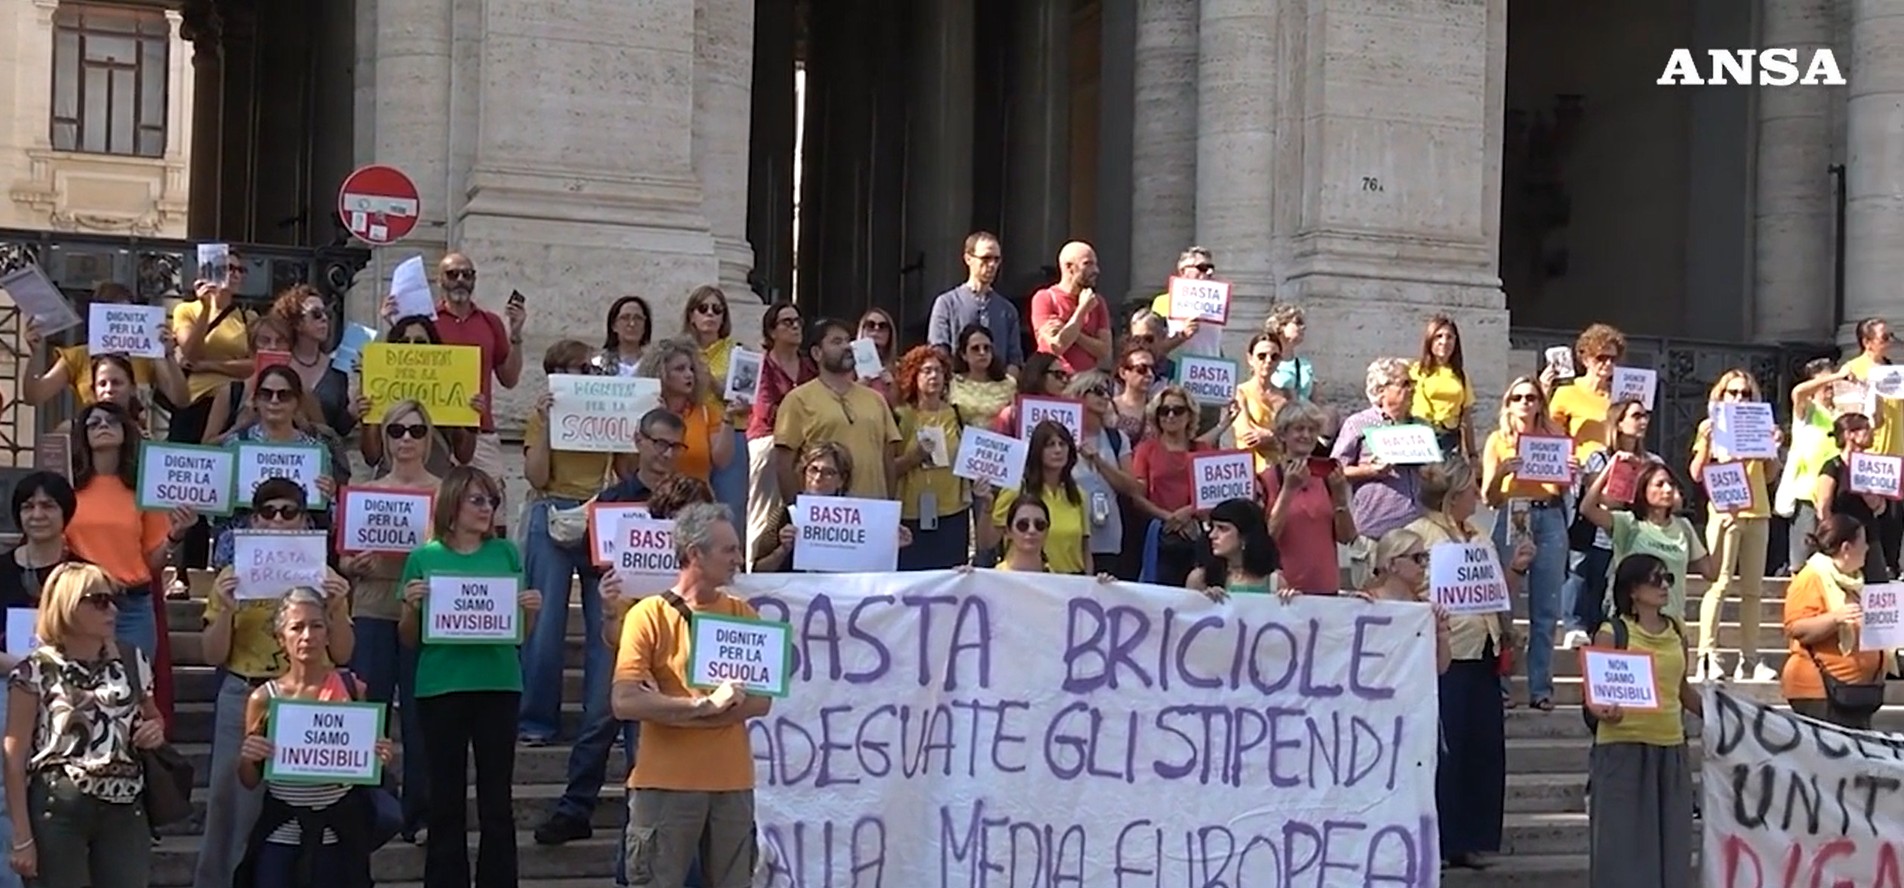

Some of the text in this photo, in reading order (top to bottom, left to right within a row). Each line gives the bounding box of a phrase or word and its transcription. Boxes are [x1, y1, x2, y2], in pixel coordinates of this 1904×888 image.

[1181, 285, 1220, 301] BASTA
[1177, 300, 1223, 314] BRICIOLE
[106, 310, 148, 323] DIGNITA'
[109, 323, 144, 335] PER LA
[101, 335, 151, 350] SCUOLA
[395, 368, 416, 379] PER
[1189, 365, 1230, 383] BASTA
[370, 377, 465, 408] SCUOLA
[1183, 381, 1233, 398] BRICIOLE
[586, 401, 606, 411] PER
[1032, 408, 1075, 426] BASTA
[562, 414, 633, 441] SCUOL
[975, 436, 1012, 453] DIGNITA'
[165, 455, 216, 471] DIGNITA'
[257, 453, 306, 467] DIGNITA'
[976, 447, 1005, 464] PER LA
[1532, 453, 1557, 462] PER LA
[261, 467, 301, 479] PER LA
[966, 458, 1008, 479] SCUOLA
[1204, 462, 1247, 482] BASTA
[1525, 463, 1563, 475] SCUOLA
[1858, 459, 1895, 475] BASTA
[168, 471, 210, 485] PER LA
[1711, 470, 1742, 488] BASTA
[1854, 473, 1897, 490] BRICIOLE
[157, 485, 218, 503] SCUOLA
[1201, 481, 1251, 500] BRICIOLE
[1712, 487, 1748, 503] BRICIOLE
[364, 499, 414, 514] DIGNITA'
[810, 505, 861, 525] BASTA
[368, 513, 408, 527] PER LA
[358, 527, 416, 545] SCUOLA
[629, 529, 673, 550] BAST
[803, 525, 865, 544] BRICIOLE
[253, 549, 306, 566] BASTA
[622, 552, 681, 570] BRICIOL
[1464, 548, 1490, 563] NON
[1457, 565, 1495, 582] SIAMO
[461, 583, 488, 596] NON
[453, 598, 494, 612] SIAMO
[1868, 593, 1896, 609] BASTA
[435, 613, 512, 631] INVISIBILI
[715, 628, 768, 647] DIGNITA'
[719, 645, 762, 662] PER LA
[1062, 597, 1395, 699] BRICIOLE
[707, 660, 770, 684] SCUOLA
[1608, 659, 1629, 671] NON
[1604, 670, 1635, 684] SIAMO
[1594, 683, 1651, 700] INVISIBILI
[313, 713, 344, 728] NON
[304, 730, 350, 746] SIAMO
[748, 699, 1403, 790] ADEGUATE GLI STIPENDI
[281, 747, 368, 768] INVISIBILI
[940, 799, 1085, 888] MEDIA
